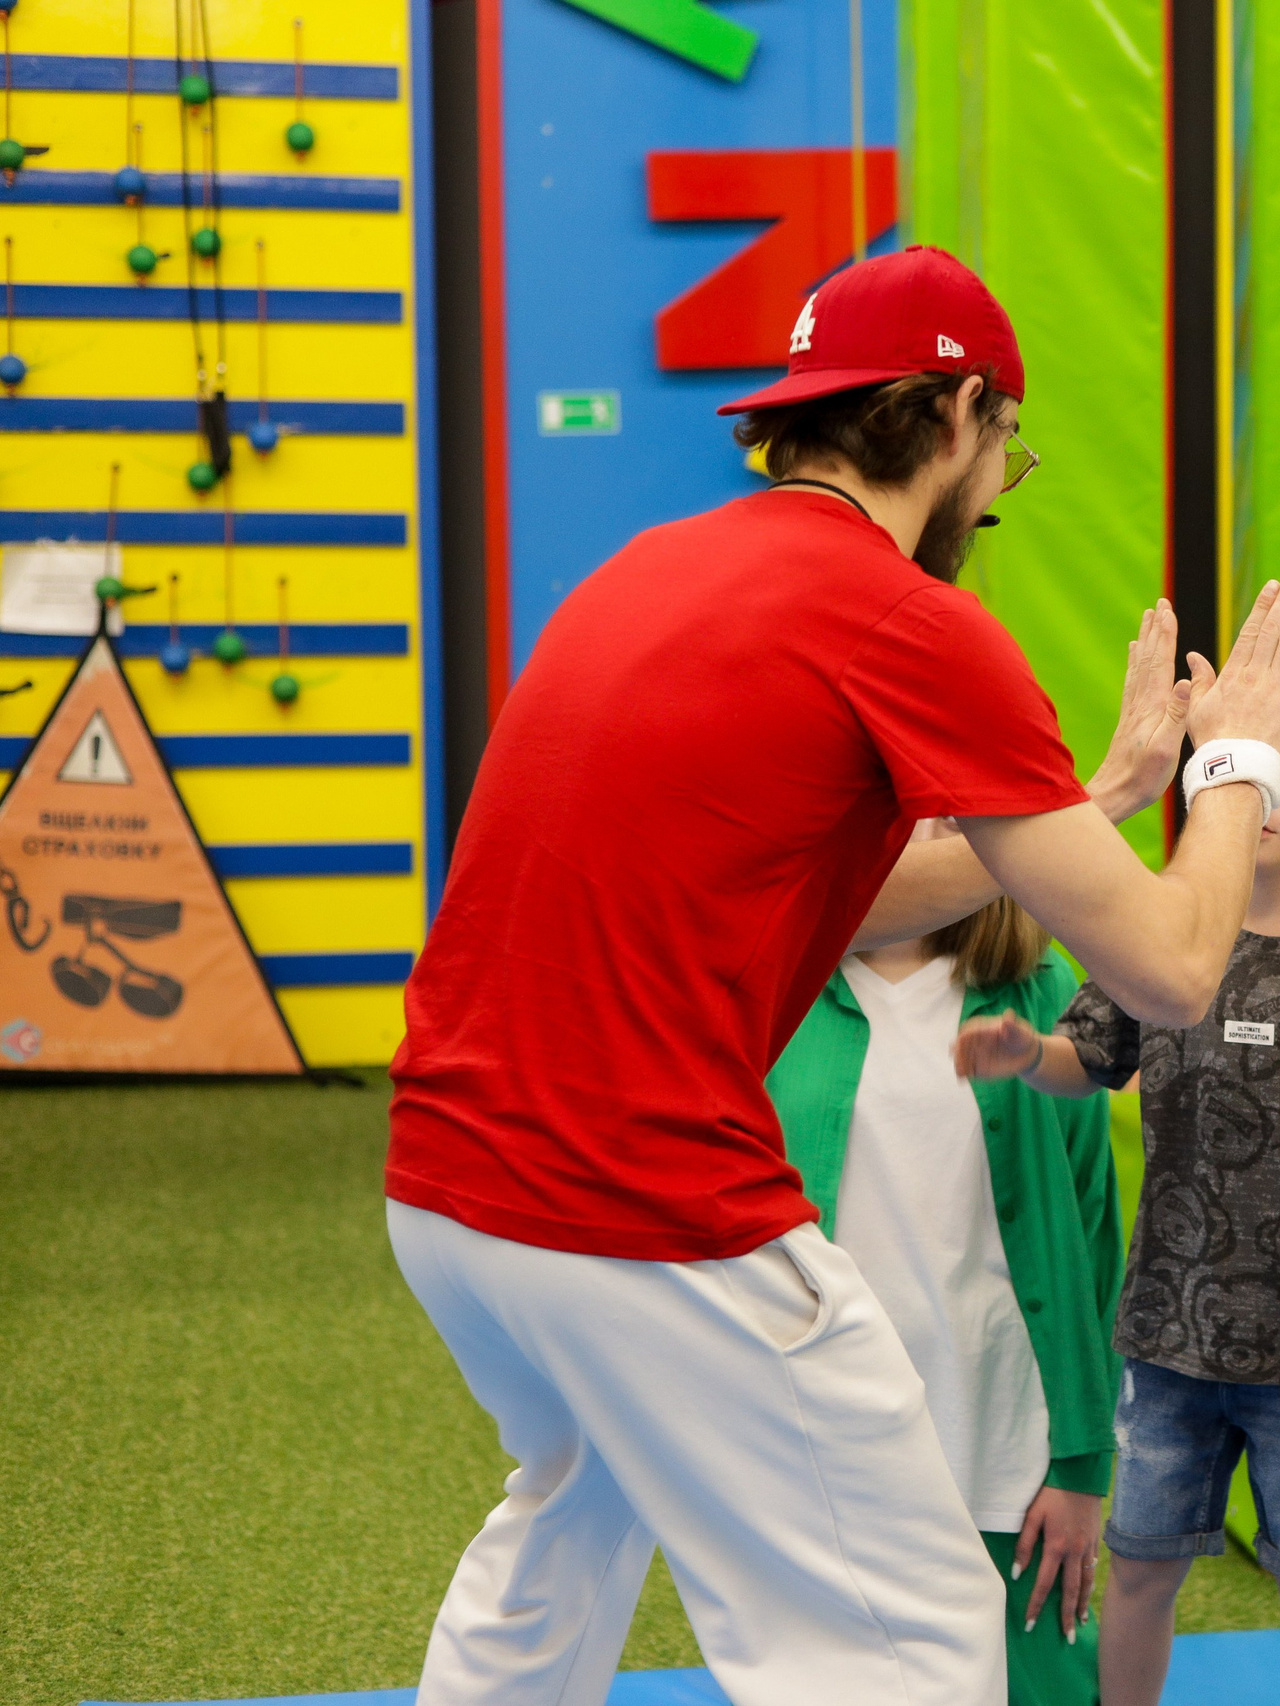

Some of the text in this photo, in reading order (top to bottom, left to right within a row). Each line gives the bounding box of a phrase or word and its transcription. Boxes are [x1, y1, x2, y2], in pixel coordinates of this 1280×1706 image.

[23, 836, 161, 859] СТРАХОВКУ
[1237, 1025, 1261, 1033] ULTIMATE
[1228, 1032, 1270, 1041] SOPHISTICATION
